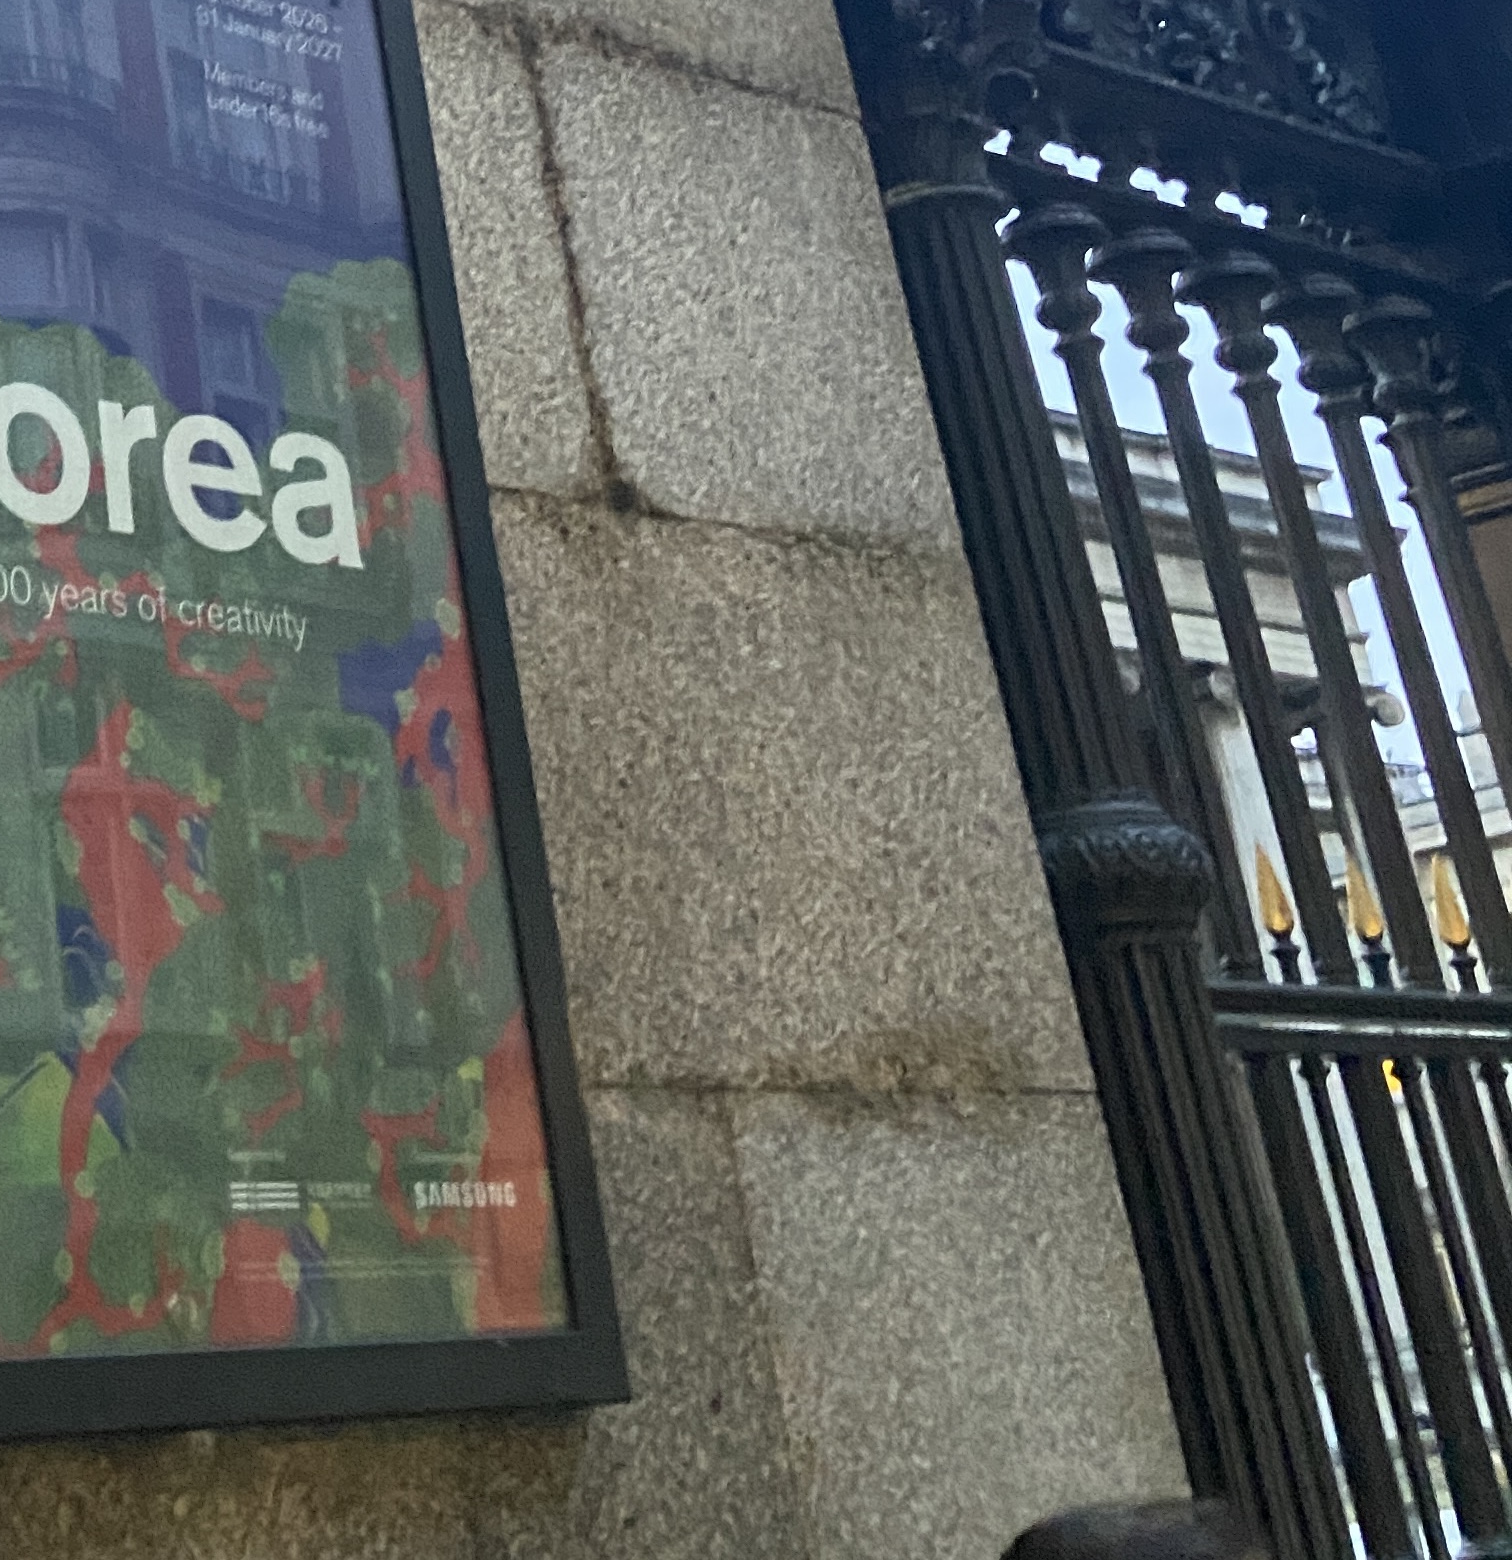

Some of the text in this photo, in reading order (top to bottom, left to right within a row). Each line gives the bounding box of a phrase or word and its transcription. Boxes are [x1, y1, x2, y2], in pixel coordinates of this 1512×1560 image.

[222, 13, 292, 53] January
[203, 59, 287, 102] Members
[41, 582, 128, 620] years
[138, 585, 170, 622] of
[178, 602, 307, 651] creativity
[414, 1181, 517, 1209] SAMSUNG
